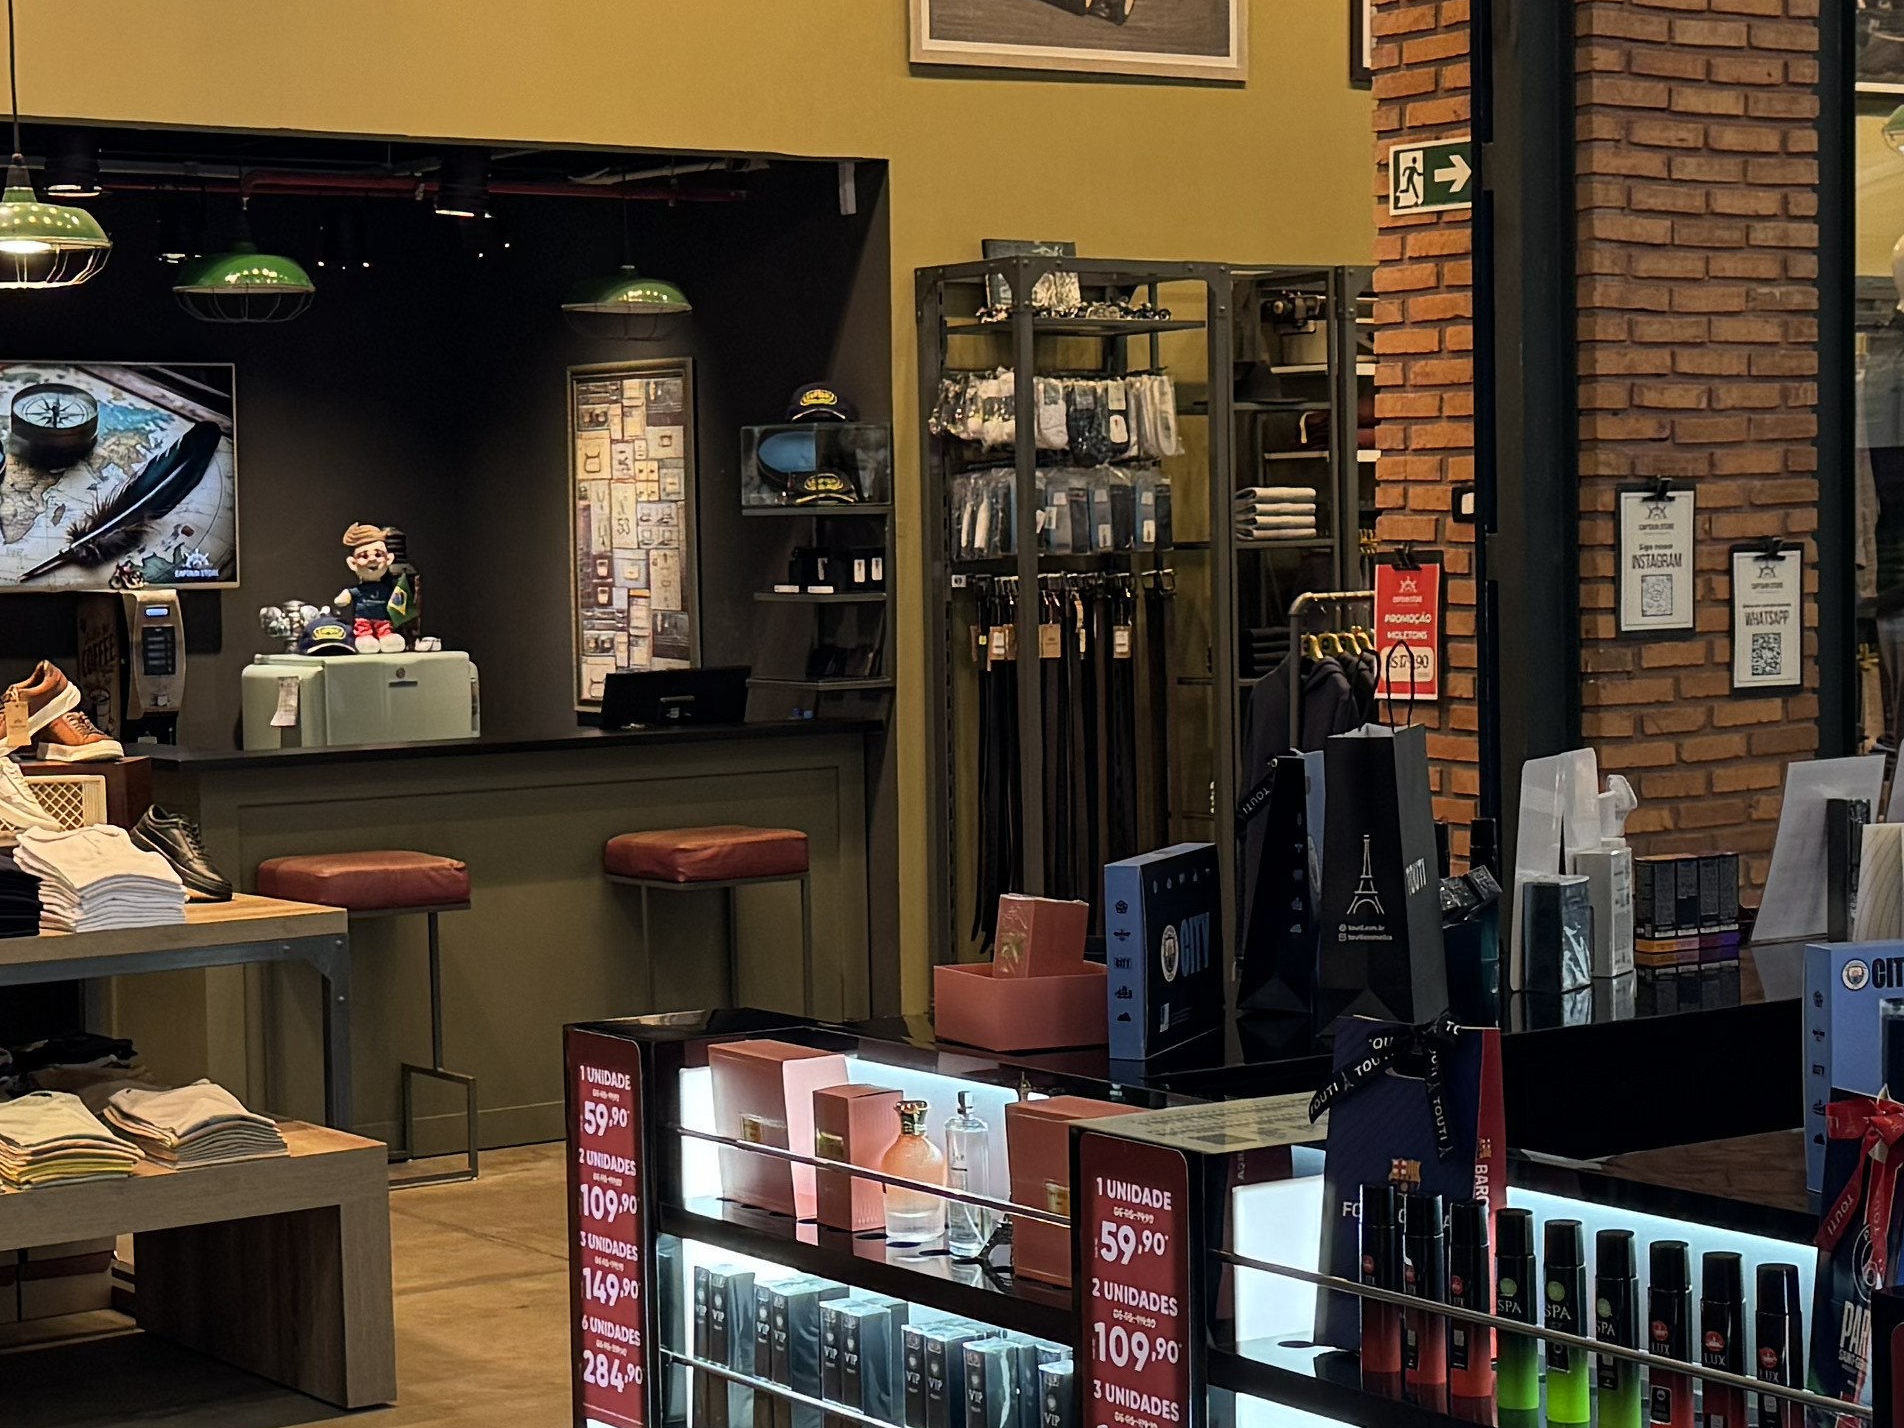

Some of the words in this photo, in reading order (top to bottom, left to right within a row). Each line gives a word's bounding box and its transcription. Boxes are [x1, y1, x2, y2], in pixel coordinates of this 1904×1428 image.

[1632, 553, 1682, 569] INSTAGRAM
[1745, 610, 1789, 626] WHATSAPP
[1180, 912, 1209, 977] CITY
[1433, 1098, 1447, 1141] TOUTI
[1096, 1177, 1103, 1196] 1
[1107, 1179, 1172, 1211] UNIDADE
[1827, 1194, 1855, 1236] TOUTI
[1092, 1278, 1100, 1297] 2
[1104, 1281, 1178, 1317] UNIDADES
[1497, 1299, 1521, 1314] SPA
[1544, 1304, 1571, 1320] SPA
[1596, 1321, 1615, 1337] SPA
[1651, 1343, 1670, 1356] LUX
[1704, 1352, 1726, 1367] LUX
[1759, 1370, 1779, 1383] LUX
[1093, 1380, 1102, 1399] 3
[1105, 1383, 1179, 1422] UNIDADES
[1044, 1413, 1060, 1427] VIP
